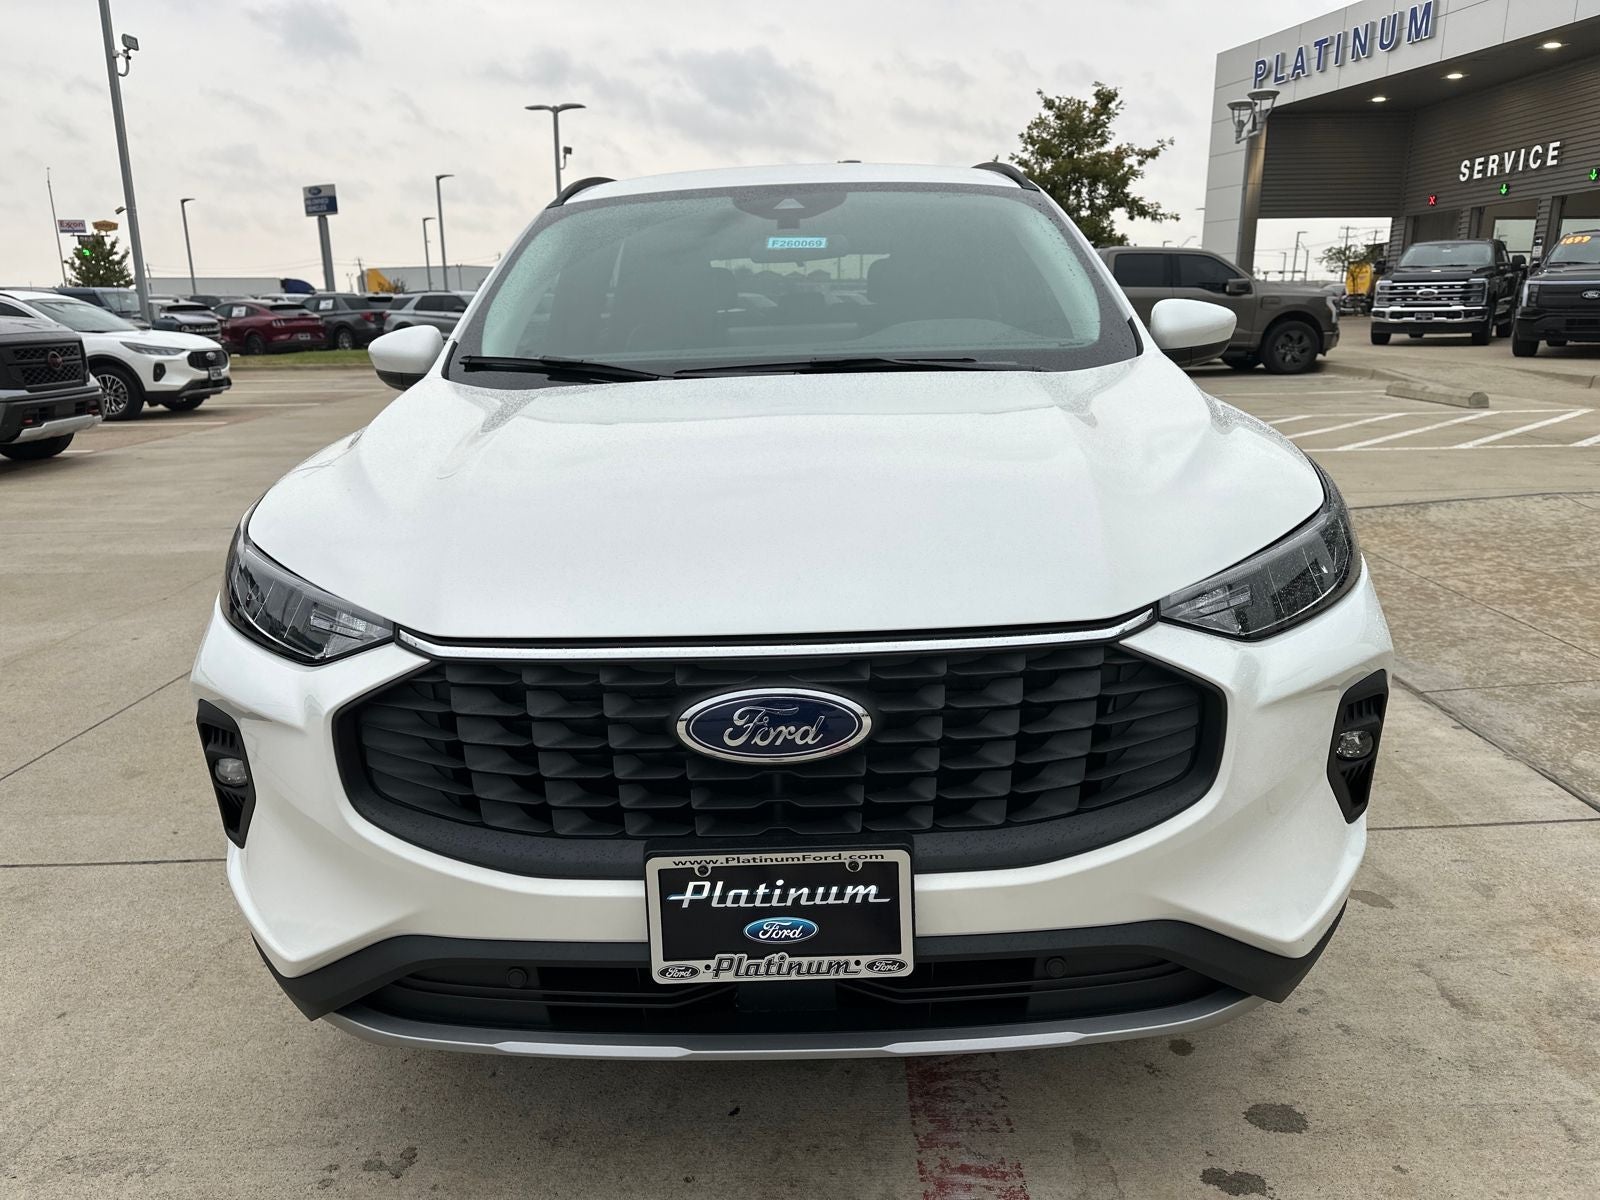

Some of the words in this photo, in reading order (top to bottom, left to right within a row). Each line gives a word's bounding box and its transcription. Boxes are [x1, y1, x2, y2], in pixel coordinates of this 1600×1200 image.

[1253, 0, 1434, 89] PLATINUM
[1459, 141, 1561, 182] SERVICE
[771, 239, 823, 248] F260069
[723, 705, 825, 747] Ford
[672, 853, 885, 867] www.PlatinumFord.com
[667, 879, 891, 908] Platinum
[758, 920, 805, 940] Ford
[664, 966, 694, 979] Ford
[711, 952, 862, 979] Platinum
[872, 959, 901, 972] Ford
